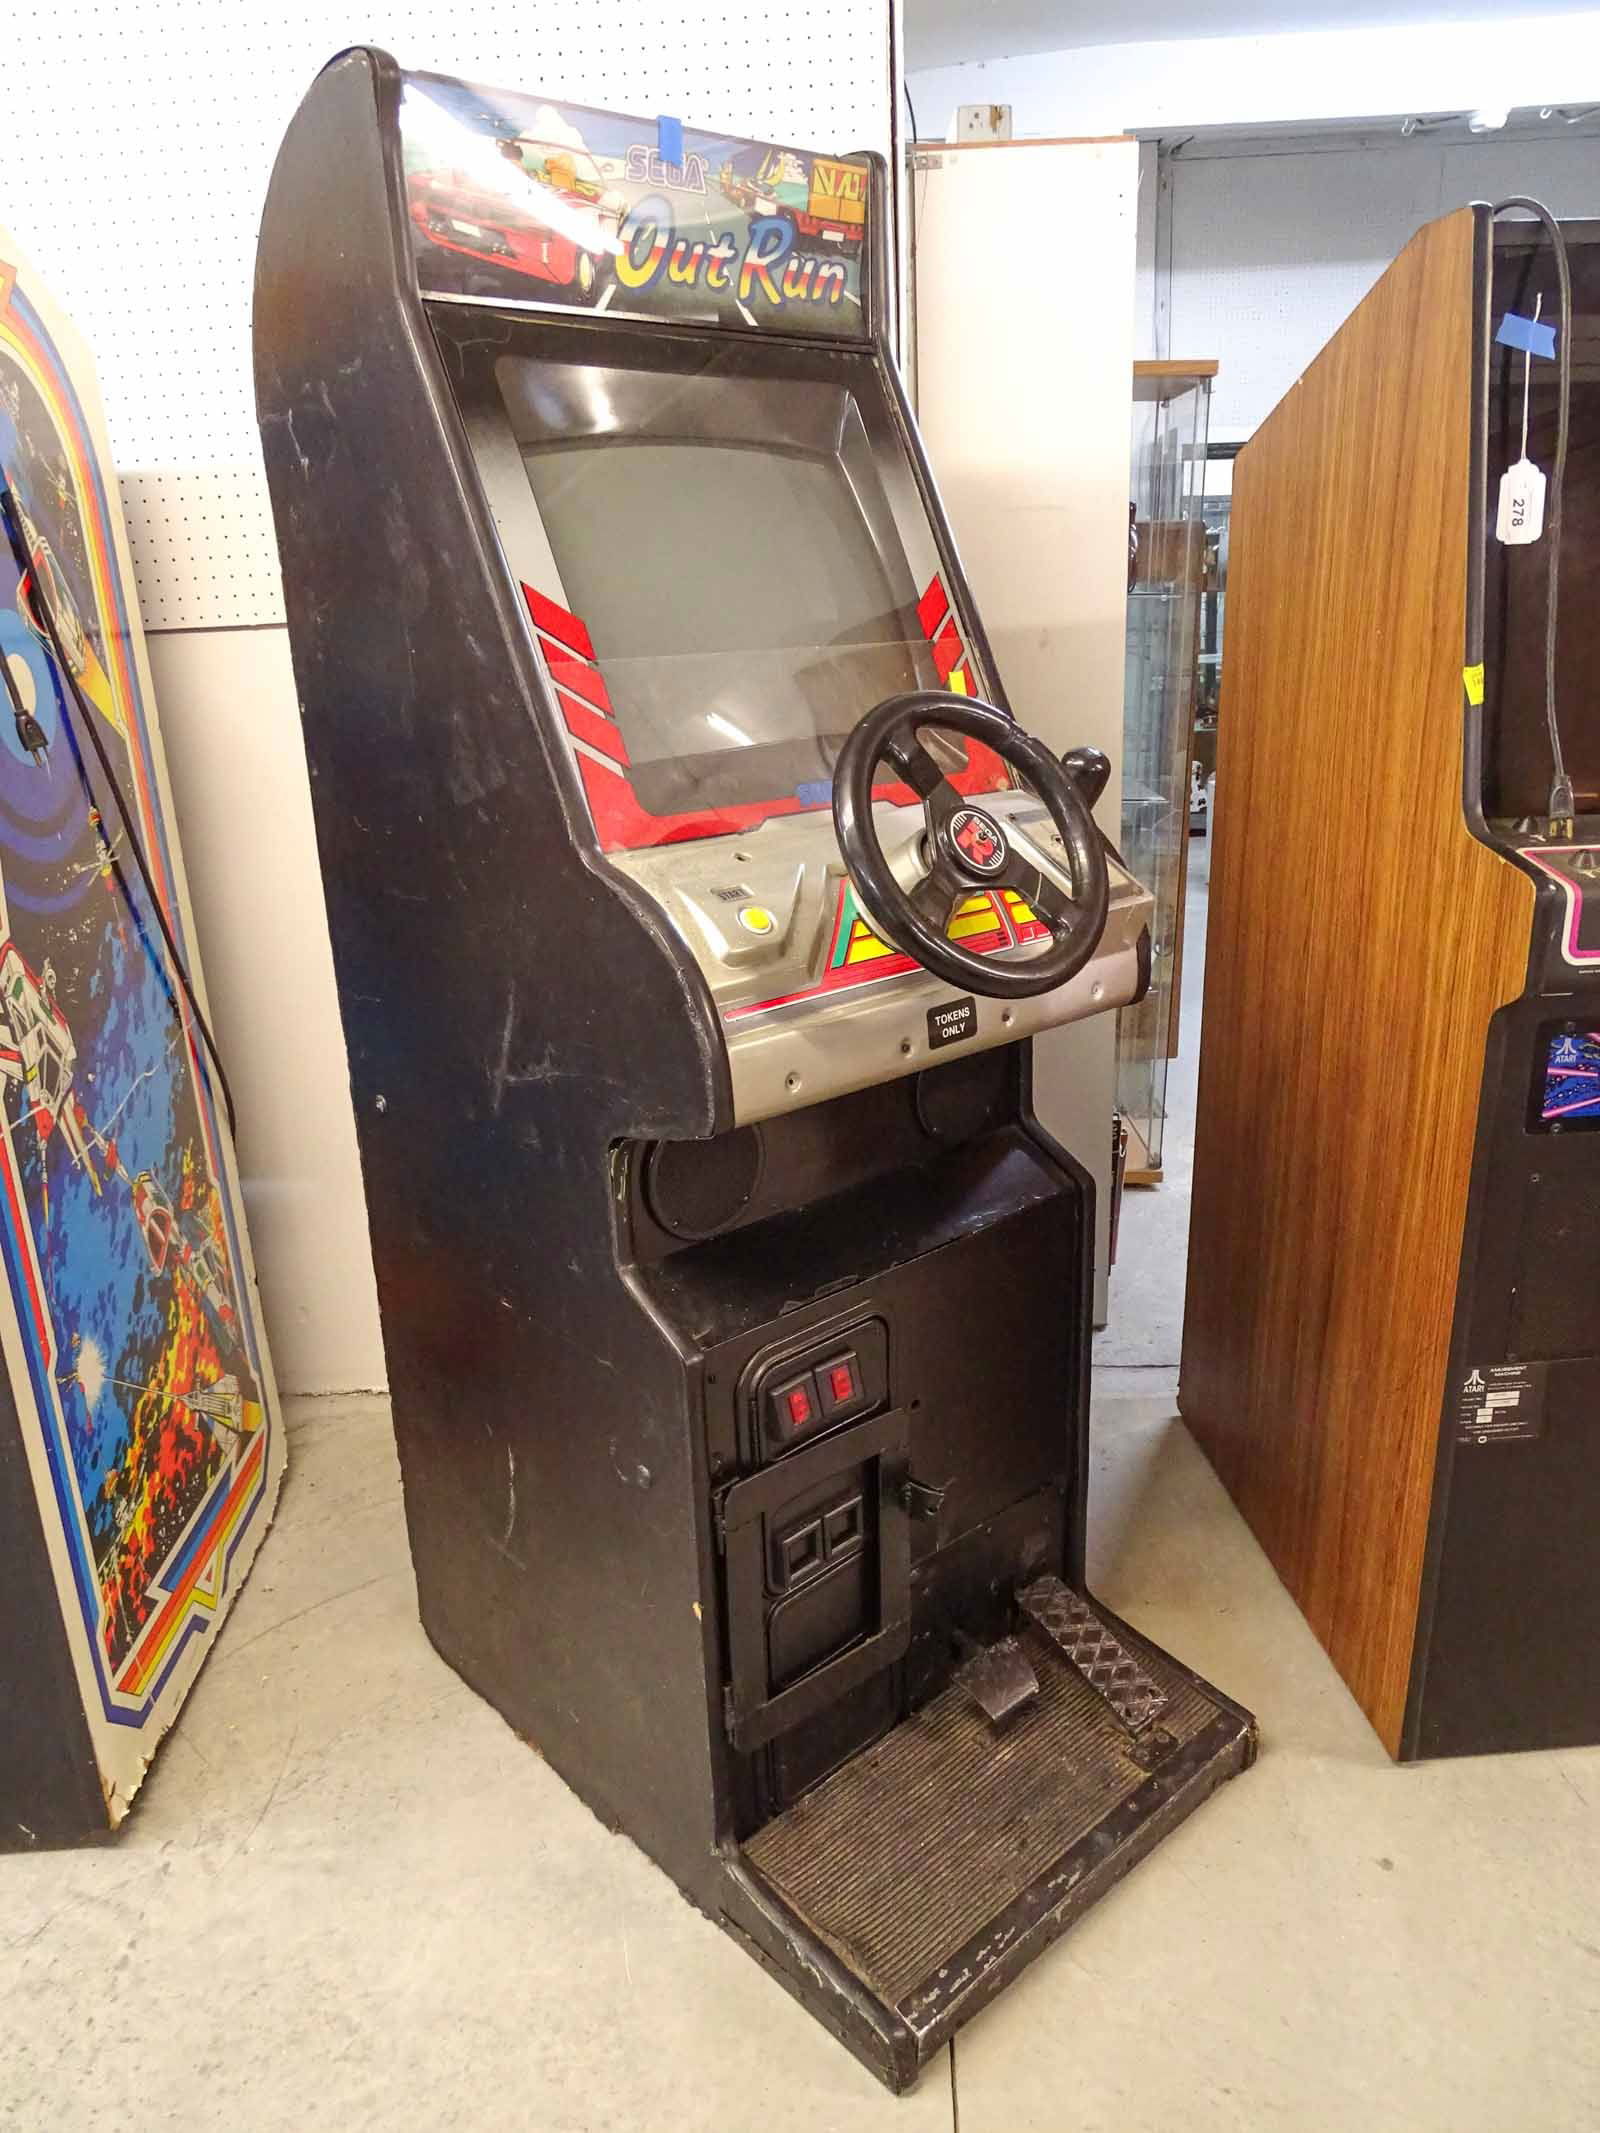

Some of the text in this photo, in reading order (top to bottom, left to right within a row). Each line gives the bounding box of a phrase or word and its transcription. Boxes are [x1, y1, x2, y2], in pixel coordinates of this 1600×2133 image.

[1512, 498, 1525, 527] 278
[934, 1006, 970, 1026] TOKENS
[942, 1022, 966, 1038] ONLY
[1554, 1055, 1577, 1064] ATARI
[1463, 1385, 1485, 1393] ATARI
